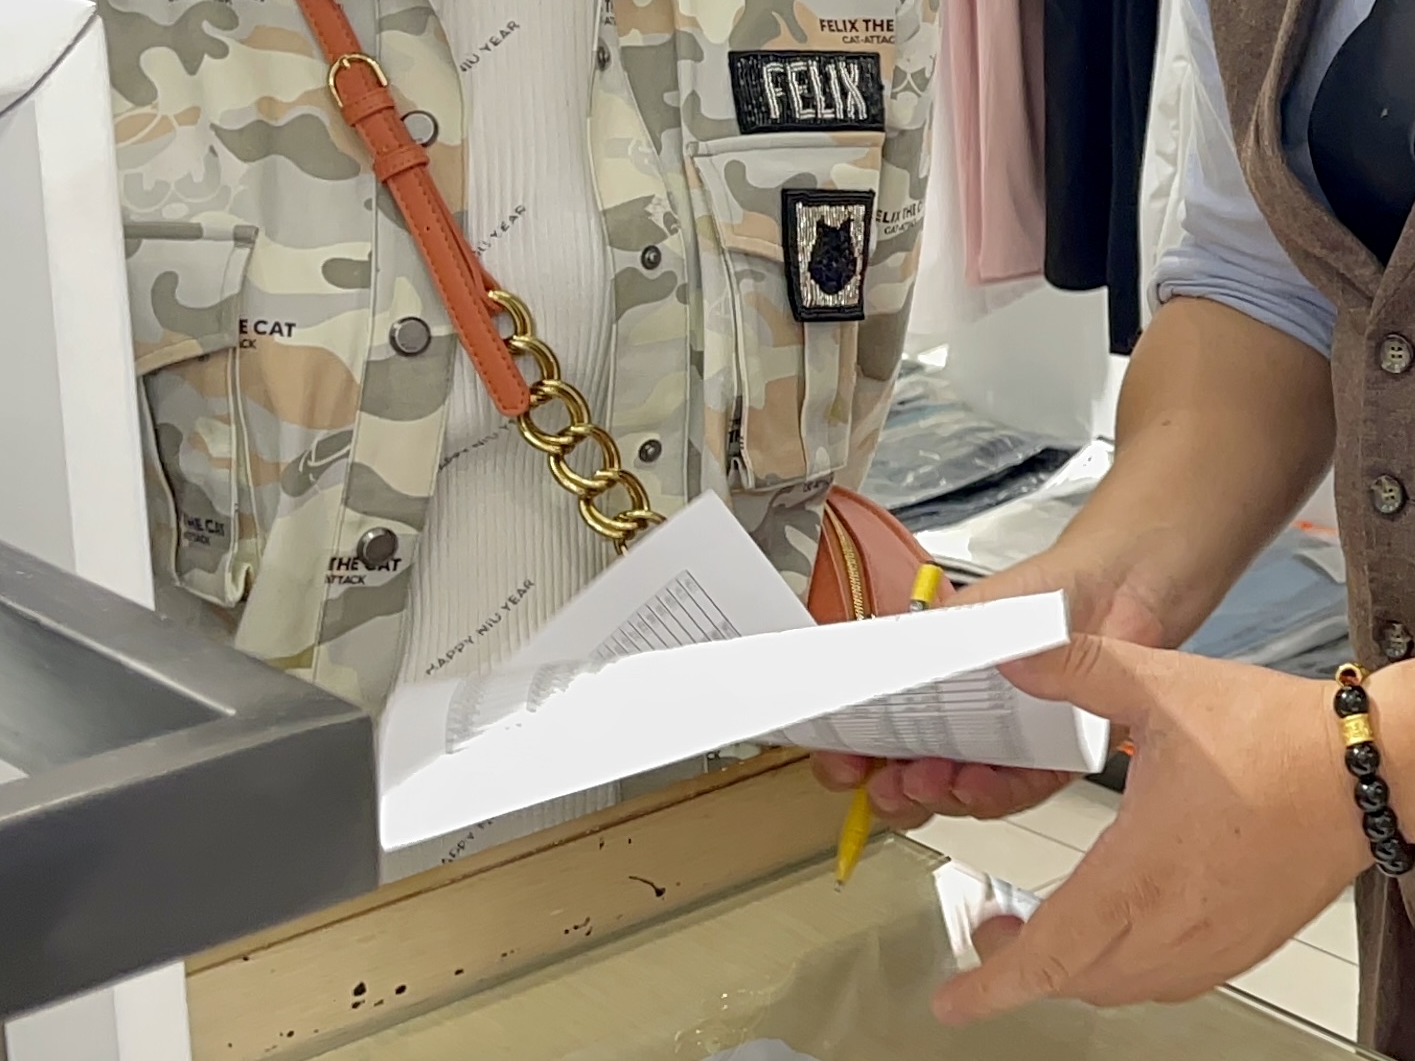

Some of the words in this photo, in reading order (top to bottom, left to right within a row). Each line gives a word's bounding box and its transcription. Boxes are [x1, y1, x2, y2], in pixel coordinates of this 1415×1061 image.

[819, 18, 859, 33] FELIX
[862, 18, 895, 33] THE
[479, 20, 521, 52] YEAR
[762, 60, 868, 121] FELIX
[876, 209, 901, 224] ELIX
[253, 320, 297, 338] CAT
[328, 556, 360, 571] THE
[501, 579, 536, 612] YEAR
